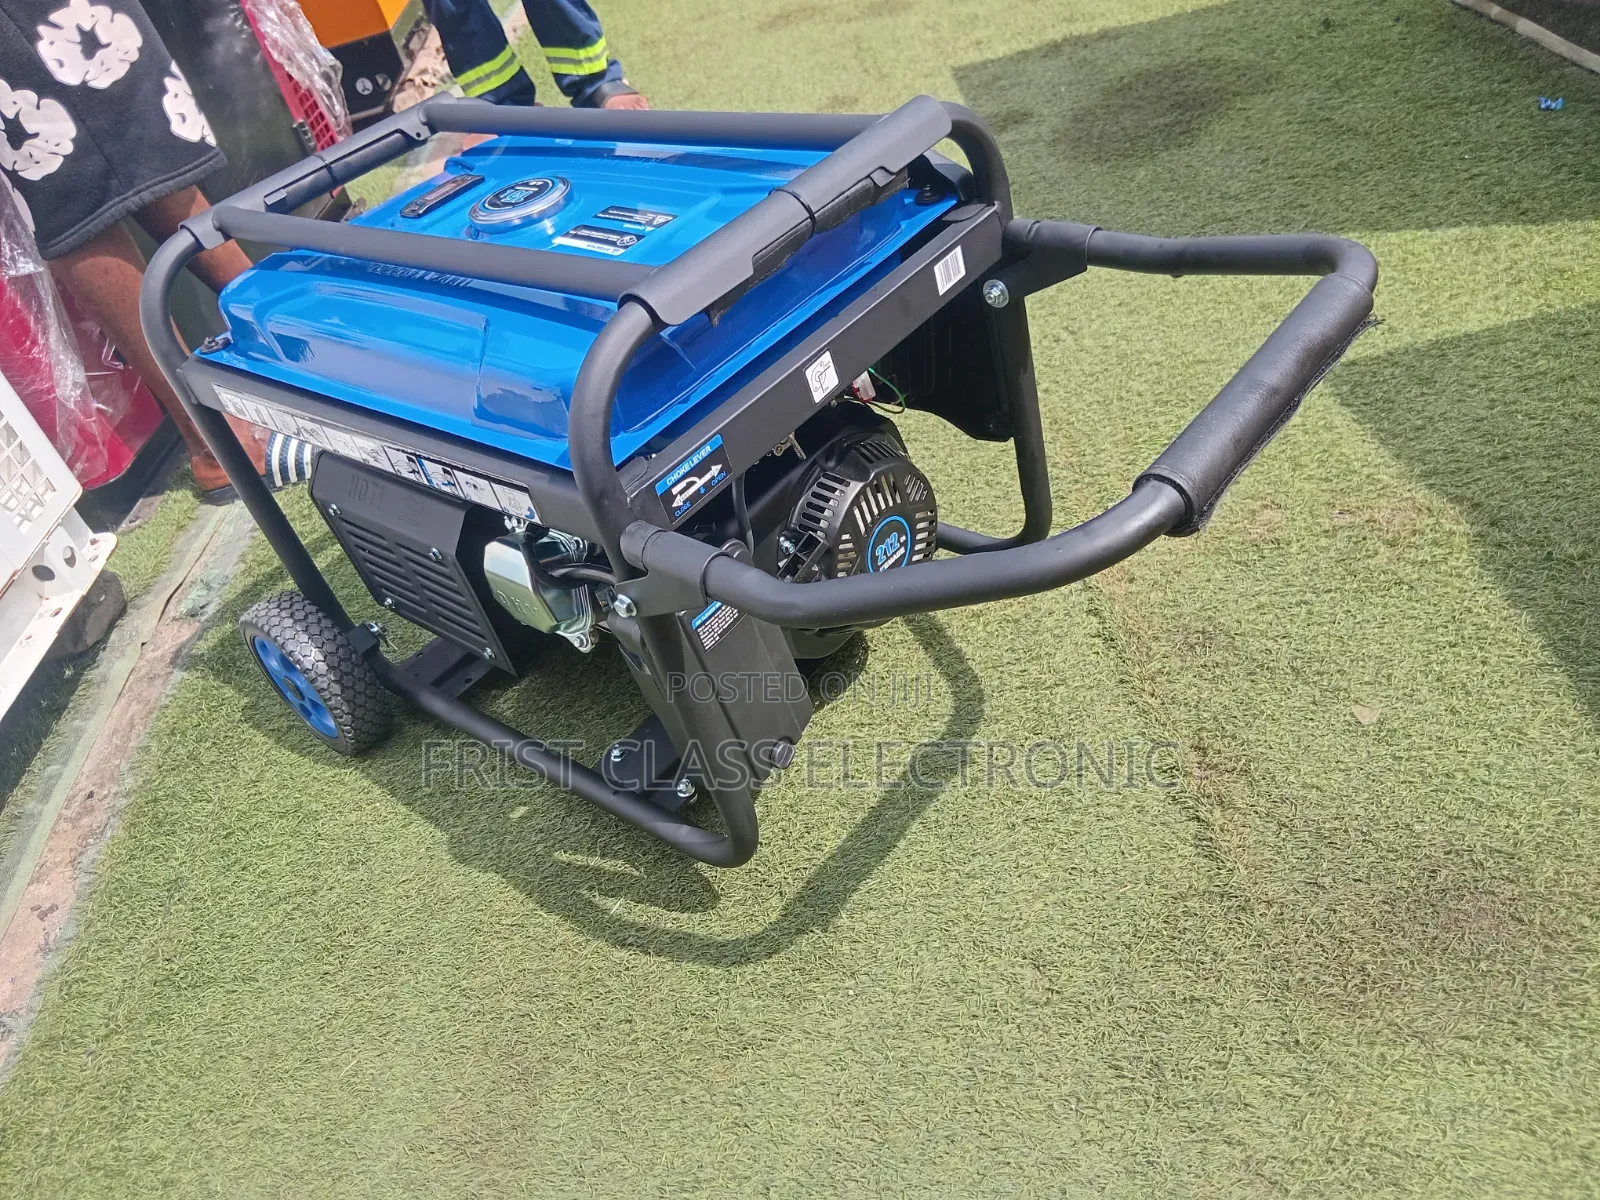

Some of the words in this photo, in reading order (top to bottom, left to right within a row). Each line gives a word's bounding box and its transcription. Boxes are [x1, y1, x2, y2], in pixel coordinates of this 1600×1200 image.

[666, 460, 691, 486] CHOKE
[689, 445, 712, 466] LEVER
[711, 471, 727, 486] OPEN
[674, 501, 691, 517] CLOSE
[876, 532, 900, 565] 212
